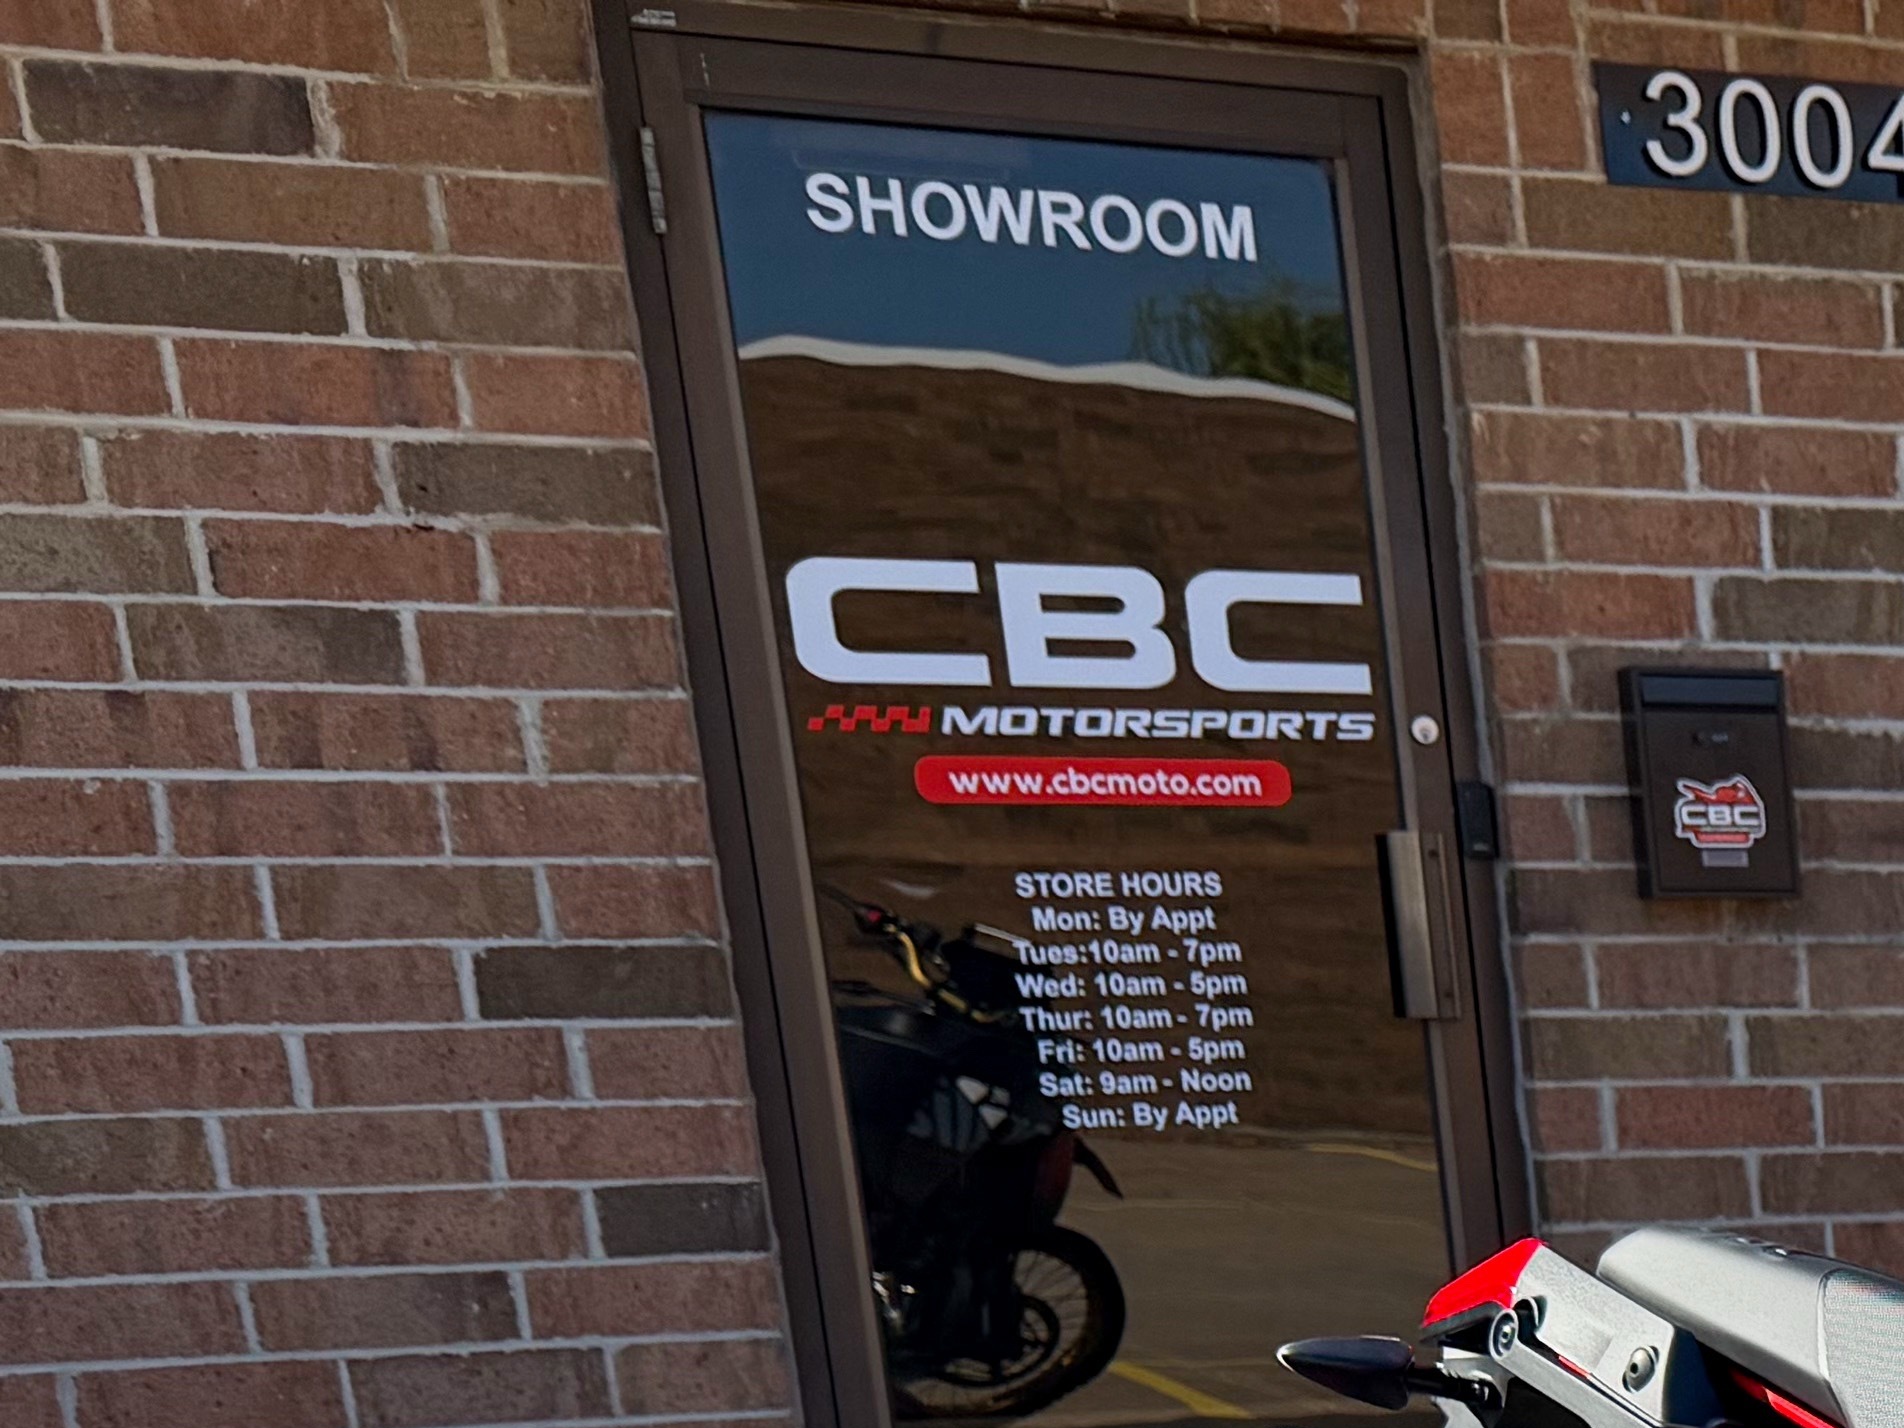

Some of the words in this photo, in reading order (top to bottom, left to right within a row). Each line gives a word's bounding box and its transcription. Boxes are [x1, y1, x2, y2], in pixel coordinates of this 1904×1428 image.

[804, 172, 1259, 263] SHOWROOM
[784, 556, 1374, 697] CBC
[941, 705, 1377, 741] MOTORSPORTS
[948, 765, 1263, 798] www.cbcmoto.com
[1680, 803, 1761, 826] CBC
[1014, 871, 1115, 898] STORE
[1120, 870, 1223, 897] HOURS
[1031, 906, 1102, 932] Mon:
[1107, 906, 1144, 936] By
[1151, 905, 1218, 935] Appt
[1182, 938, 1243, 967] 7pm
[1014, 972, 1086, 998] Wed:
[1094, 971, 1167, 997] 10am
[1190, 970, 1248, 1000] 5pm
[1018, 1005, 1094, 1032] Thur:
[1100, 1004, 1174, 1029] 10am
[1194, 1003, 1254, 1032] 7pm
[1037, 1038, 1085, 1064] Fri:
[1092, 1037, 1165, 1062] 10am
[1187, 1036, 1246, 1065] 5pm
[1039, 1071, 1094, 1097] Sat:
[1099, 1070, 1158, 1095] 9am
[1180, 1068, 1252, 1093] Noon
[1062, 1103, 1126, 1130] Sun:
[1132, 1101, 1168, 1131] By
[1175, 1101, 1239, 1129] Appt
